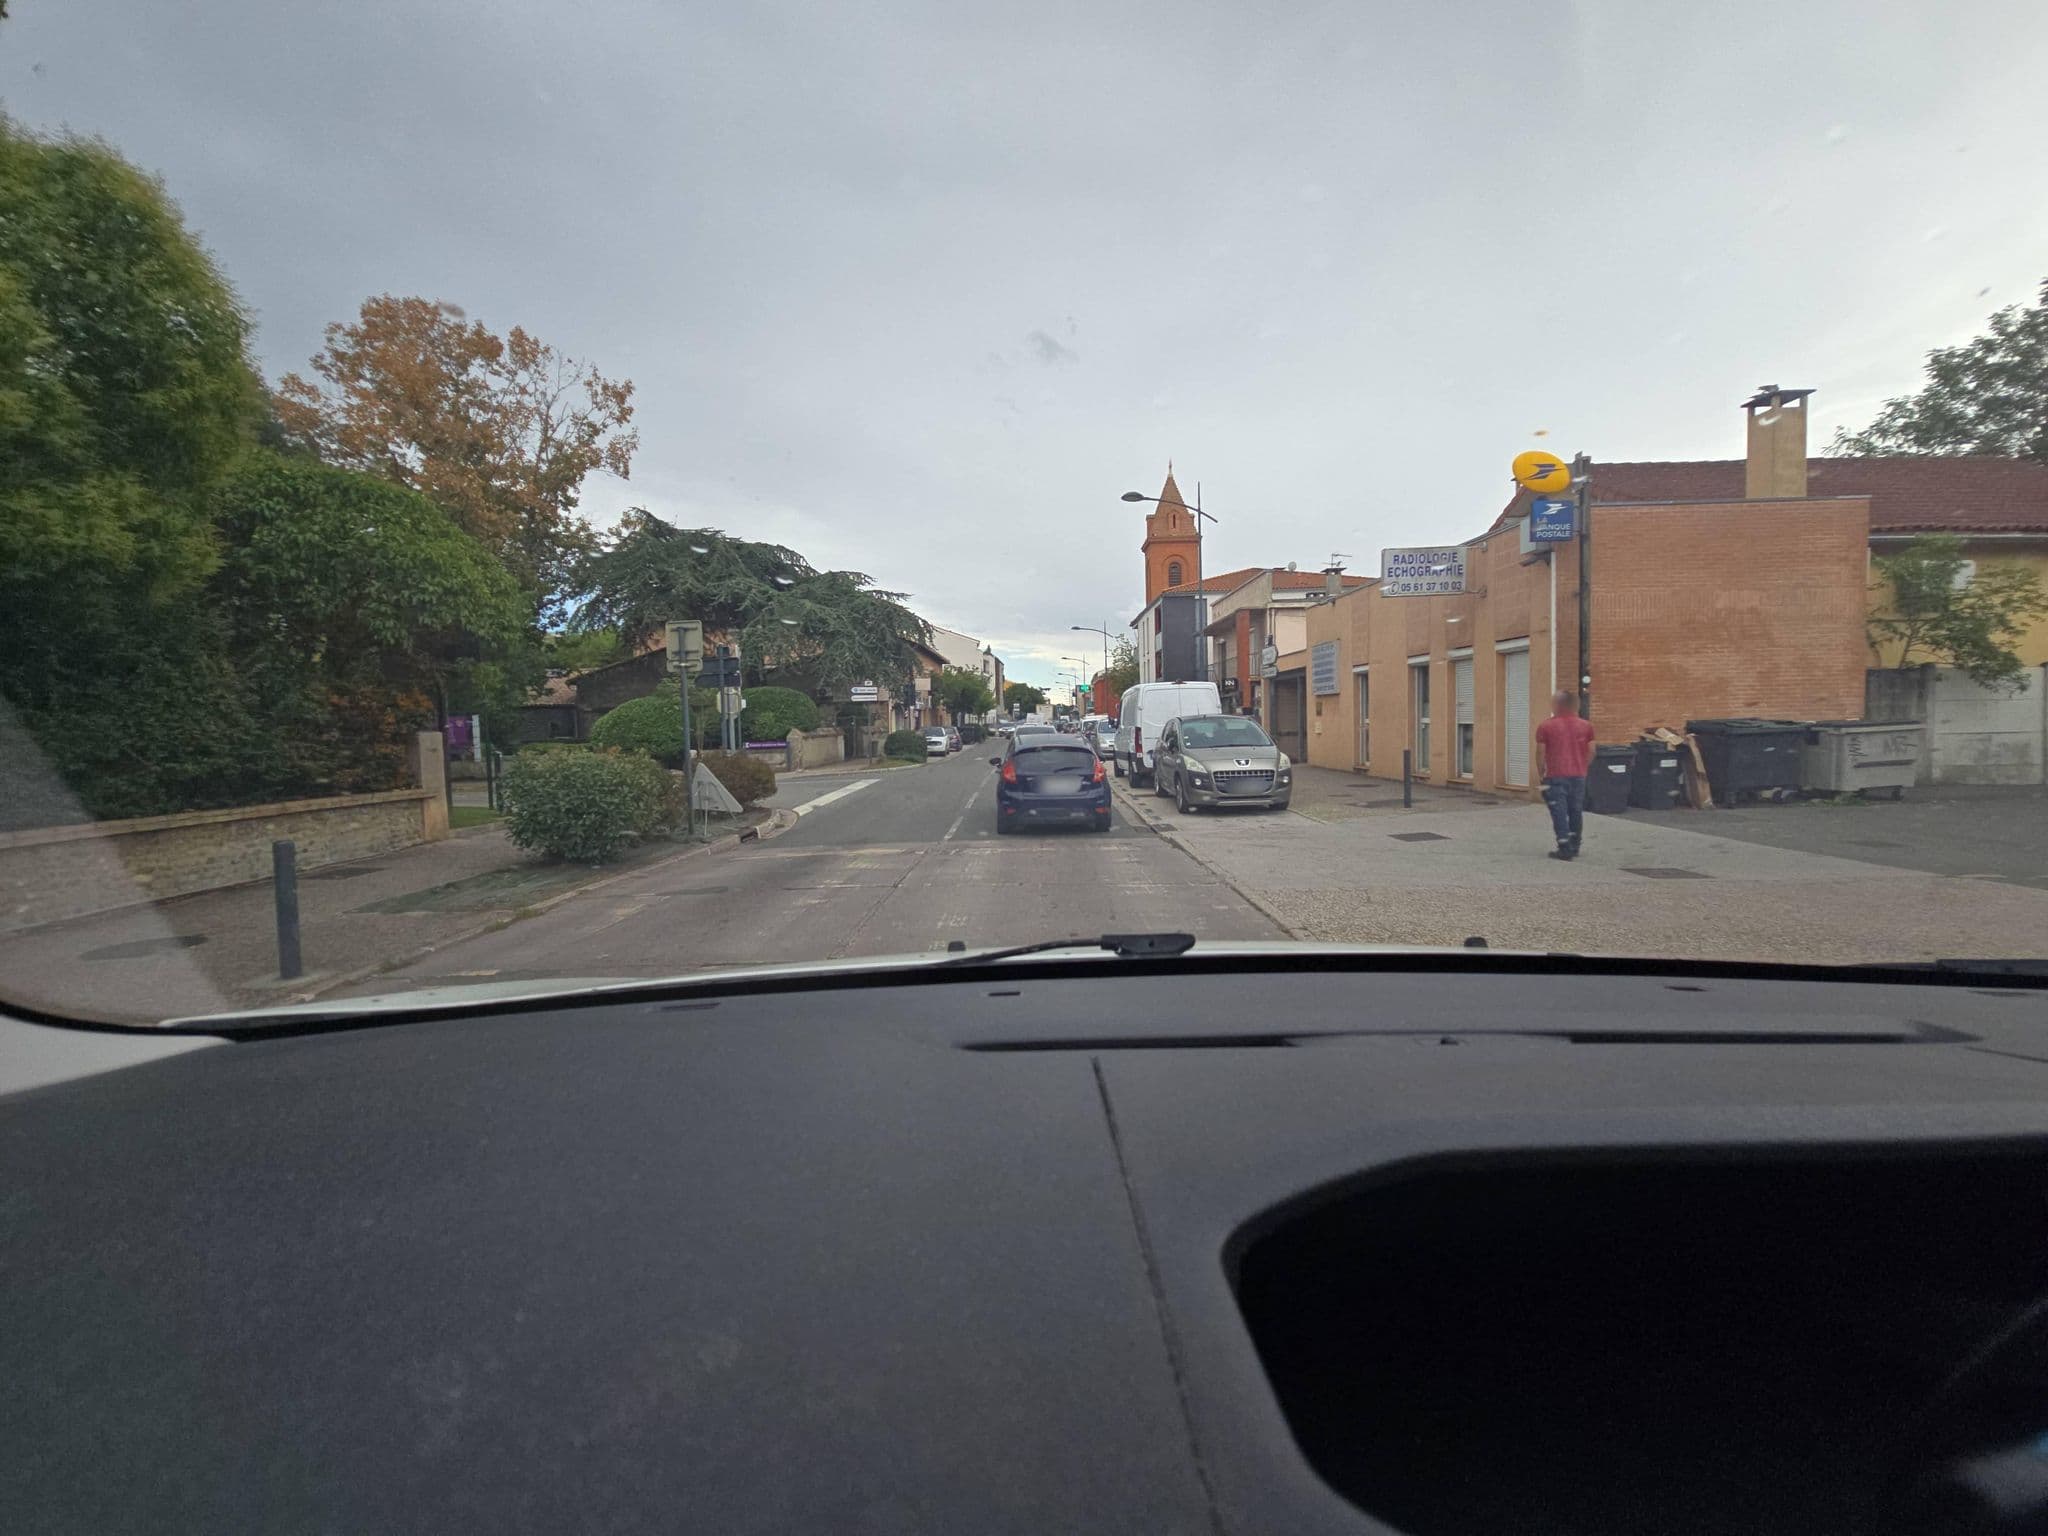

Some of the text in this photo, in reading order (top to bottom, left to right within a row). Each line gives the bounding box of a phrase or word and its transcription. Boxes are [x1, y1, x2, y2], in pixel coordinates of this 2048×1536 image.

[1393, 552, 1458, 565] RADIOLOGIE
[1387, 564, 1464, 578] ECHOGRAPHIE
[1400, 583, 1411, 592] 05
[1426, 582, 1437, 591] 37
[1439, 581, 1449, 590] 10
[1451, 581, 1462, 590] 03
